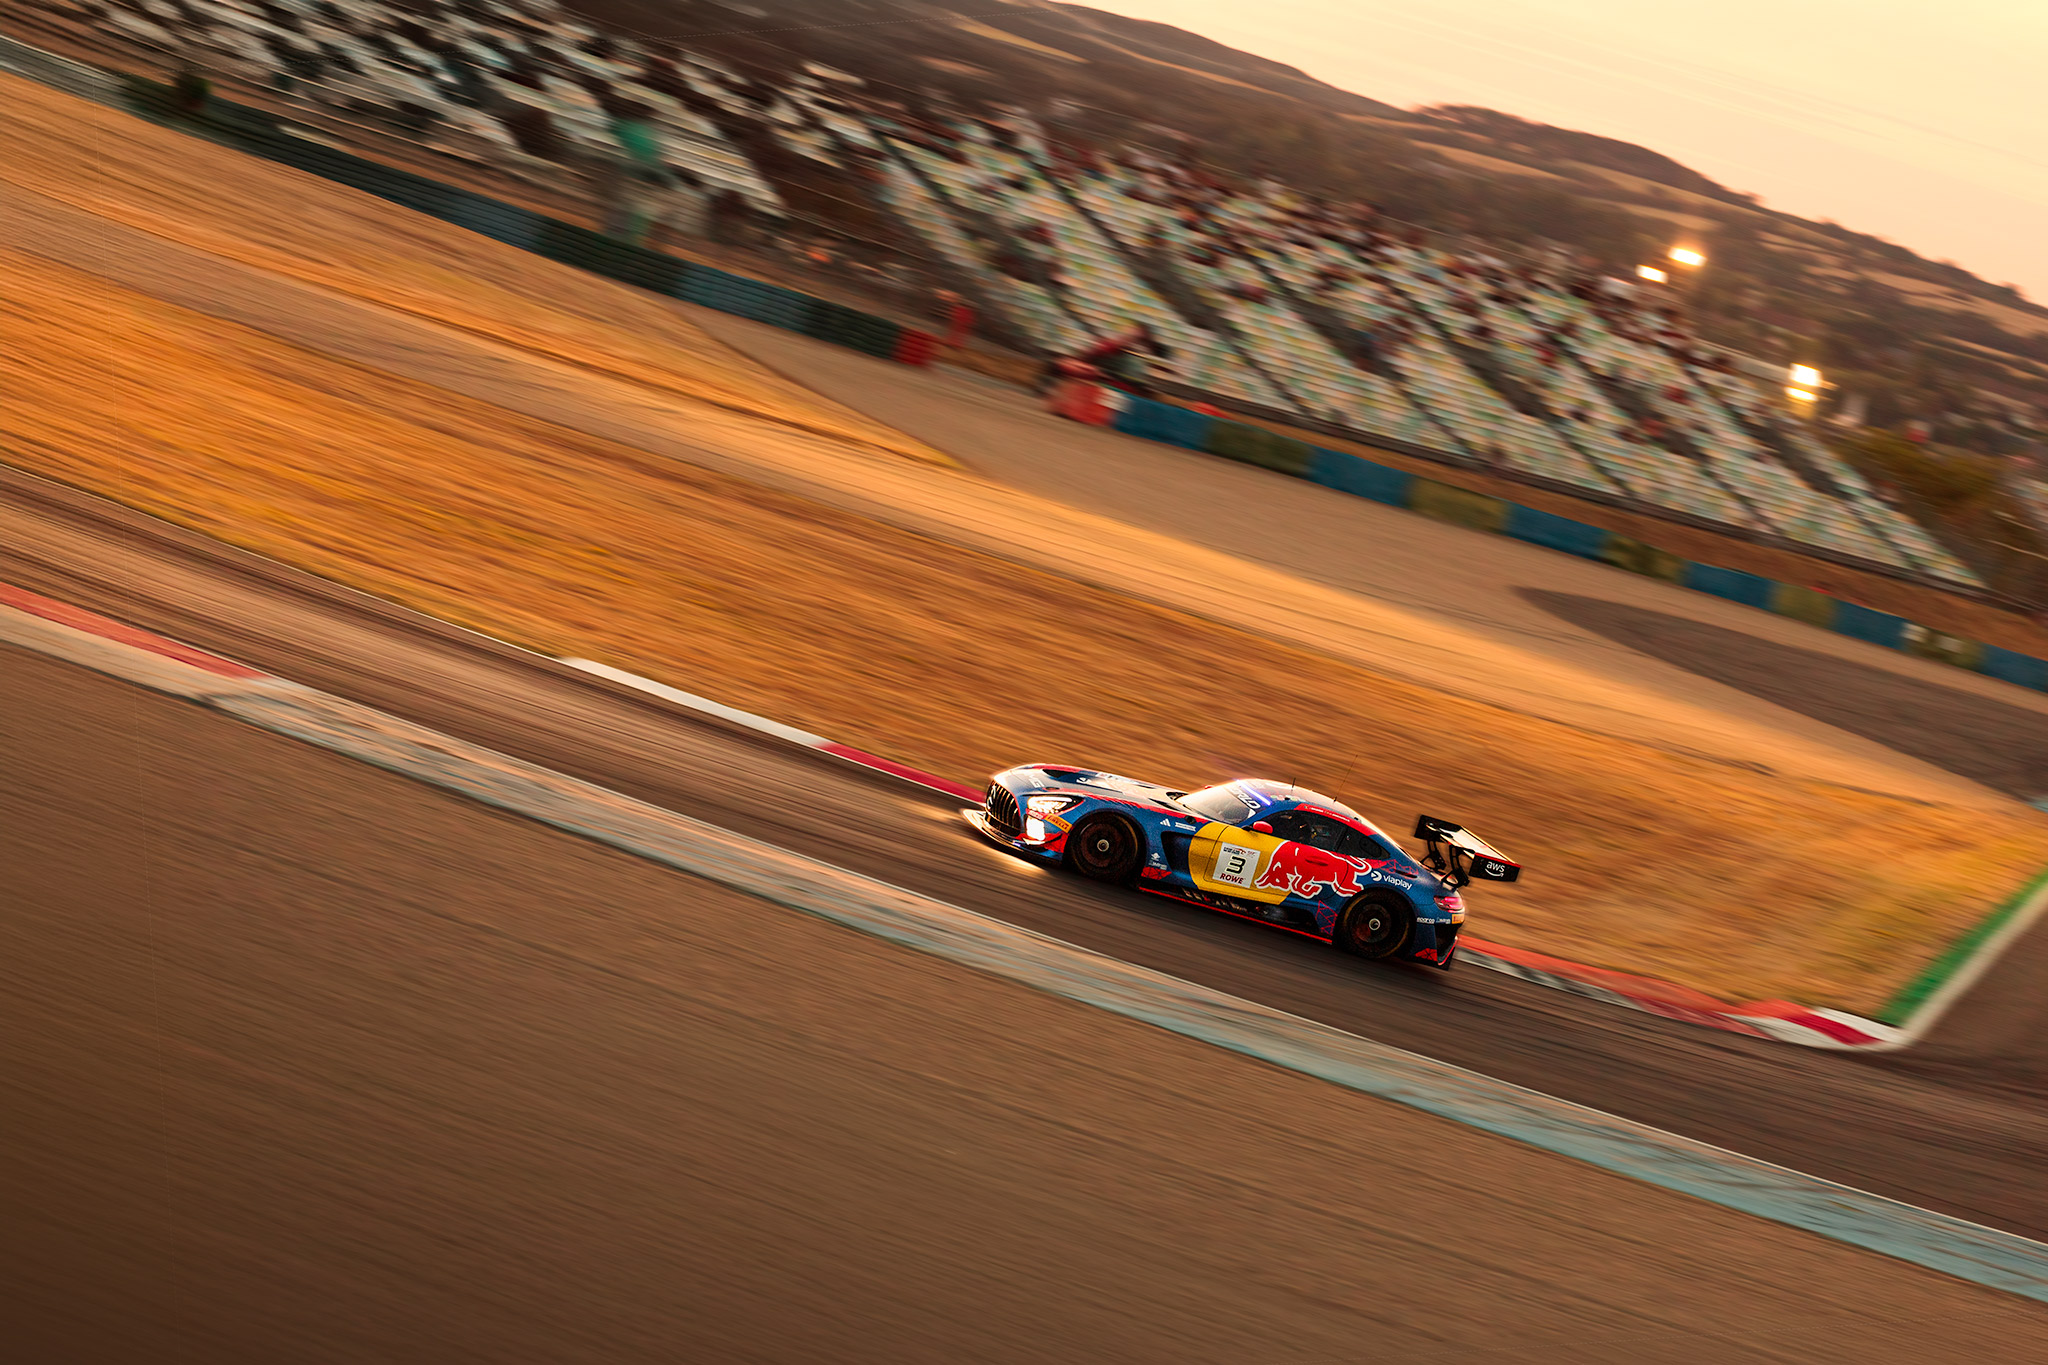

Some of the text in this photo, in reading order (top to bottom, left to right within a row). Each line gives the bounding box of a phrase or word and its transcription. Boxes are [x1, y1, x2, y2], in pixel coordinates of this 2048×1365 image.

[1047, 815, 1069, 830] PIRELLI
[1225, 855, 1247, 874] 3
[1486, 861, 1505, 873] aws
[1219, 873, 1244, 885] ROWE
[1383, 874, 1412, 891] viaplay
